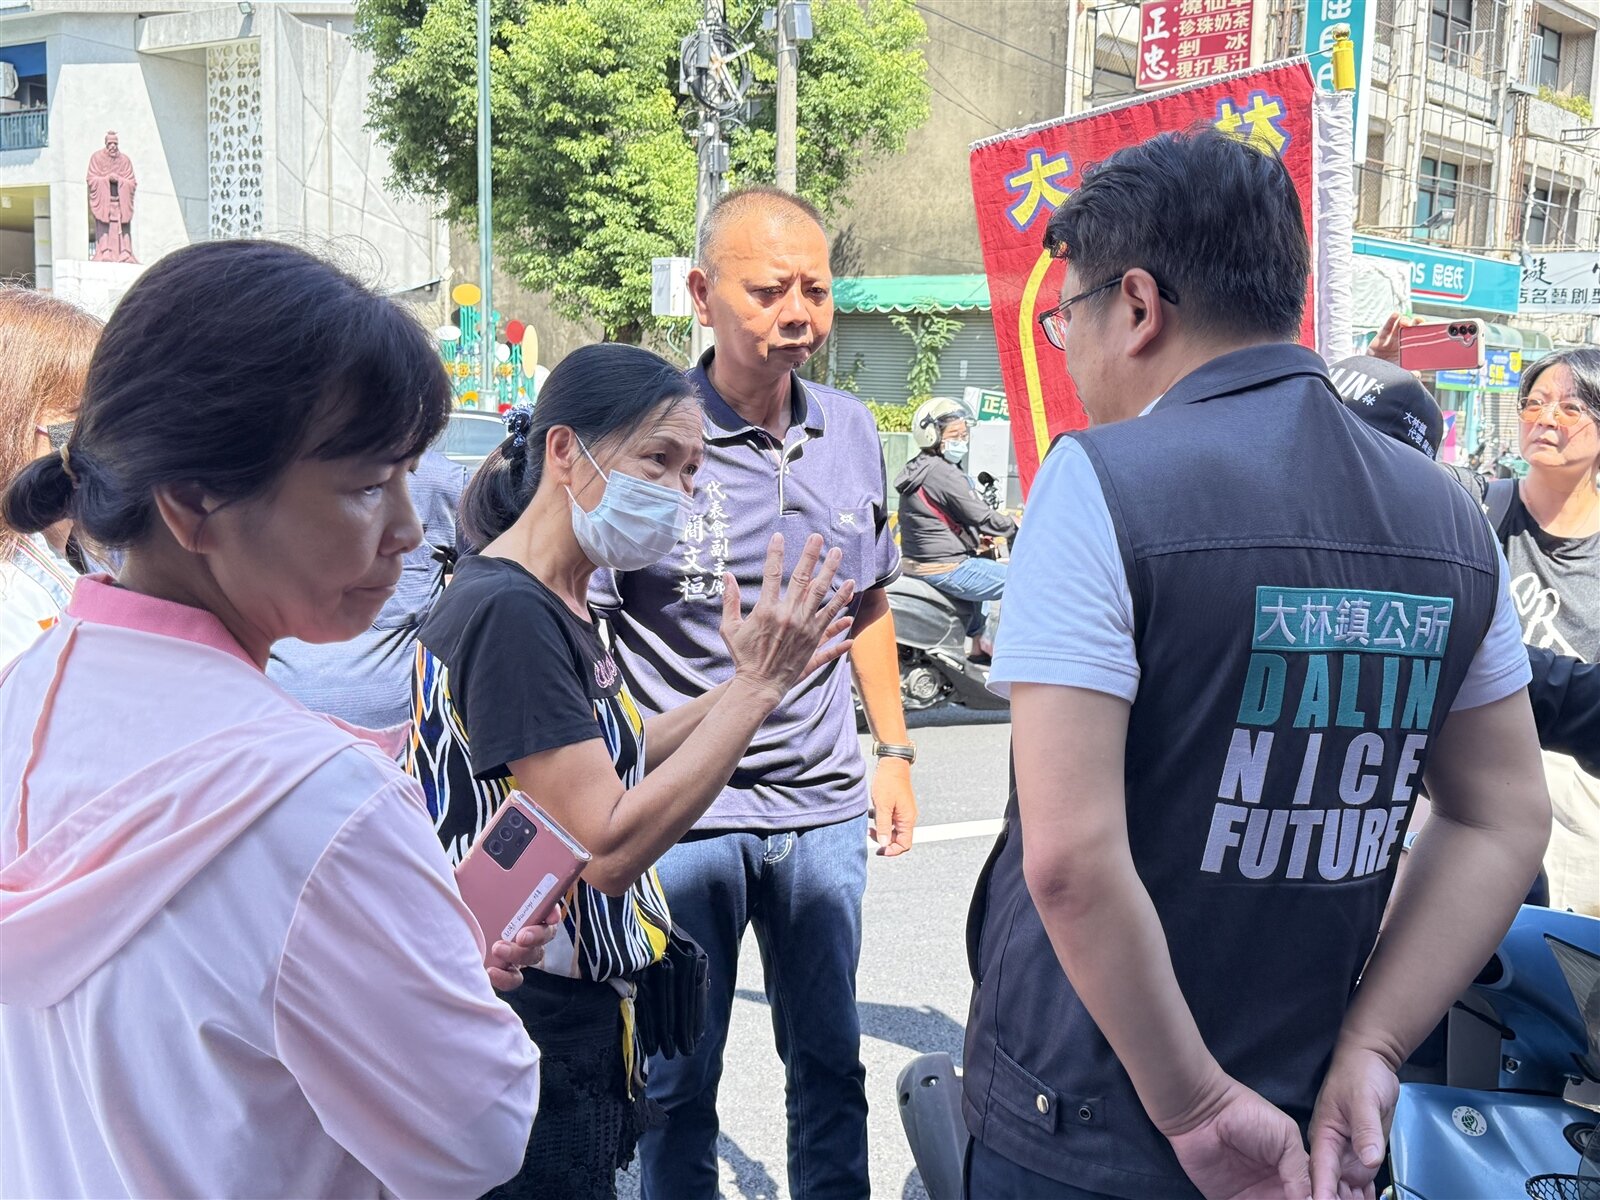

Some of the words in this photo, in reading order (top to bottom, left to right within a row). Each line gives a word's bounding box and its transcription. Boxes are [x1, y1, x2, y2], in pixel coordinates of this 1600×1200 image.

[1140, 7, 1170, 80] 正忠
[1178, 10, 1250, 37] 珍珠奶茶
[1176, 53, 1248, 79] 現打果汁
[1432, 263, 1465, 290] 屈臣氏
[1257, 595, 1450, 652] 大林鎮公所
[1236, 653, 1441, 730] DALIN
[1217, 728, 1429, 805] NICE
[1200, 802, 1408, 881] FUTURE
